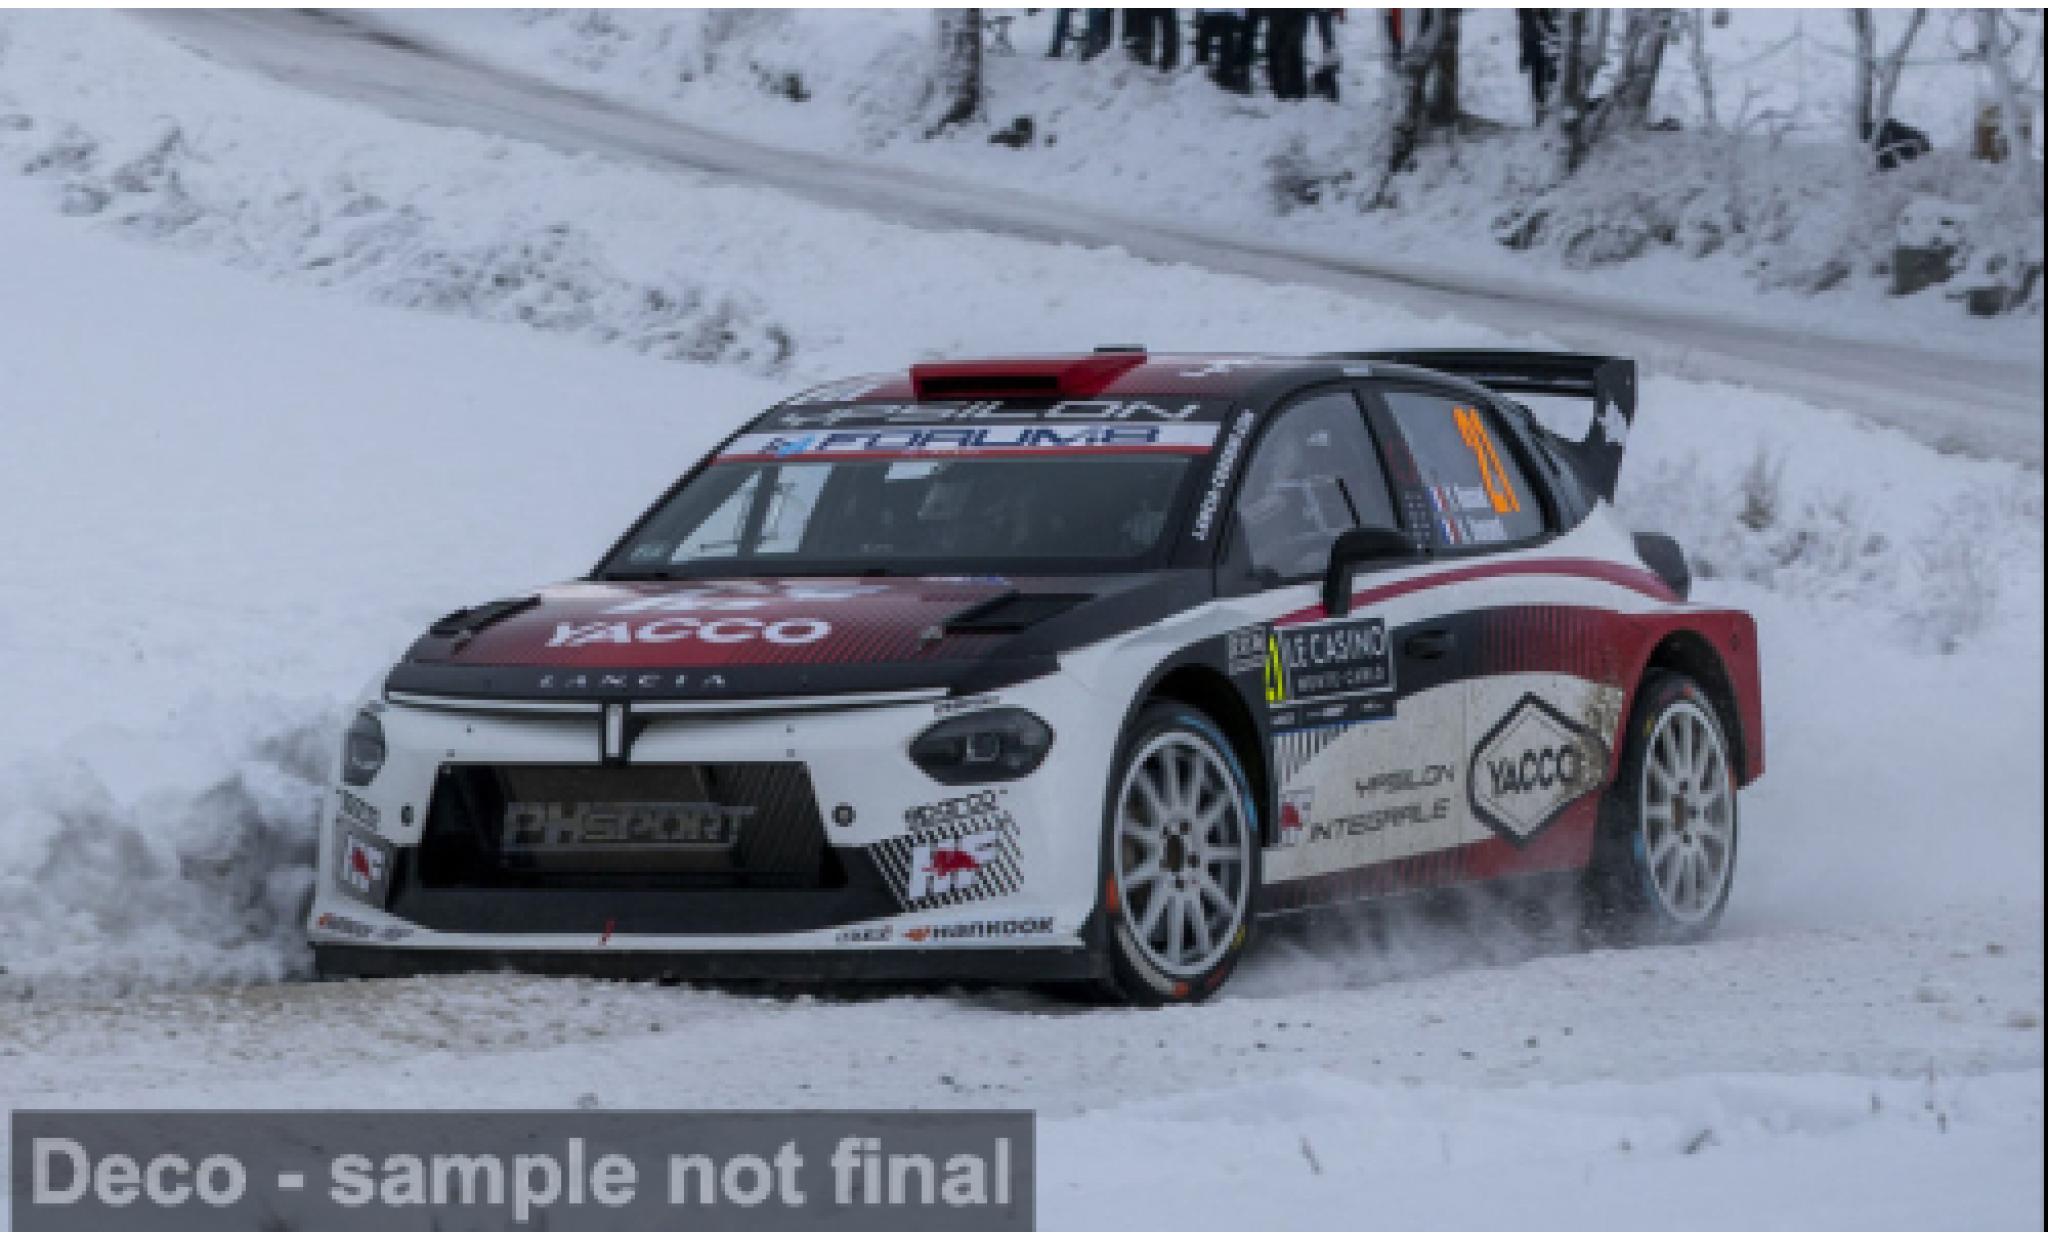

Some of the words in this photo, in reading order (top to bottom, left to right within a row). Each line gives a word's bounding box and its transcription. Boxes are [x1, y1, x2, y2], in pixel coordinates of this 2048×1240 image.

[545, 617, 832, 647] YACCO
[1310, 627, 1385, 665] CASINO
[540, 673, 727, 688] LANCIA
[1354, 764, 1455, 798] YPSILON
[1488, 746, 1580, 796] YACCO
